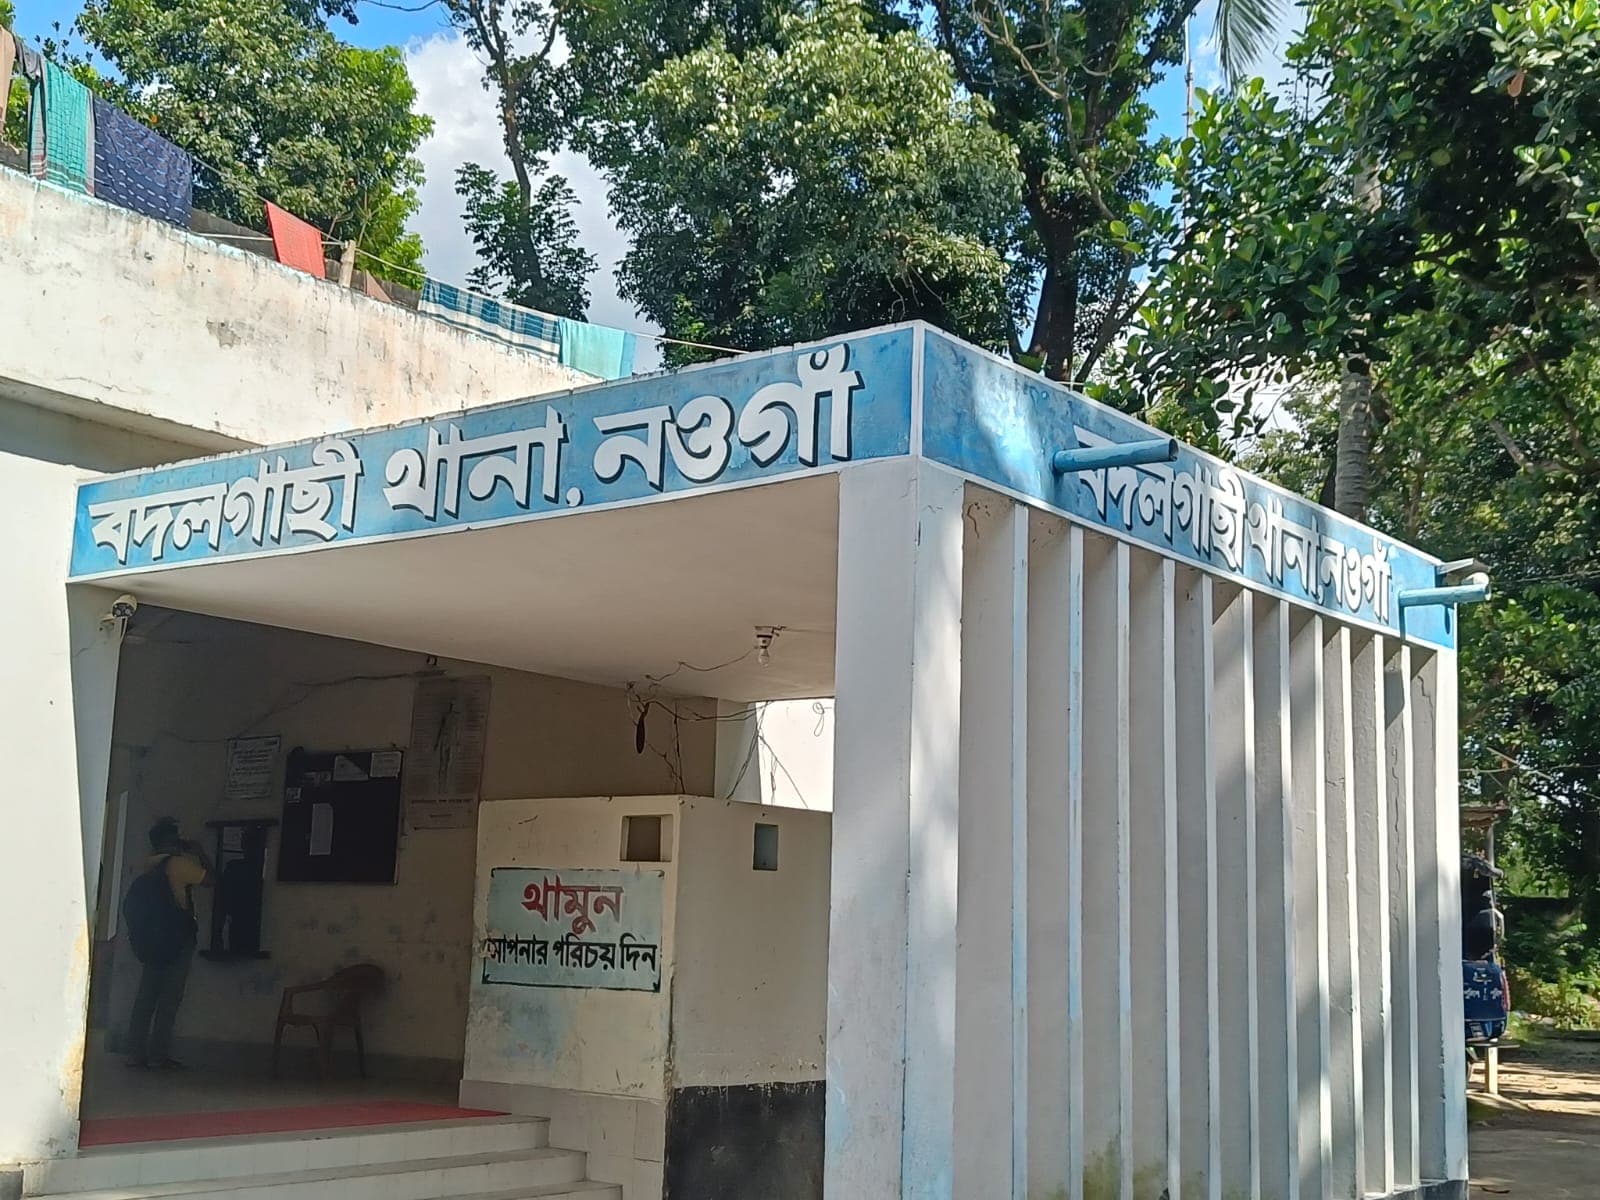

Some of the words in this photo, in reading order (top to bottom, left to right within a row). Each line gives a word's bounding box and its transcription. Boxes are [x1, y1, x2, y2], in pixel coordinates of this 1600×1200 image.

[88, 438, 365, 565] বদলগাছী
[382, 404, 584, 521] থানা,
[592, 342, 865, 492] নওগাঁ
[1320, 536, 1392, 624] নওগাঁ
[521, 874, 624, 935] থামুন
[552, 932, 617, 971] পরিচয়
[620, 932, 658, 972] দিন
